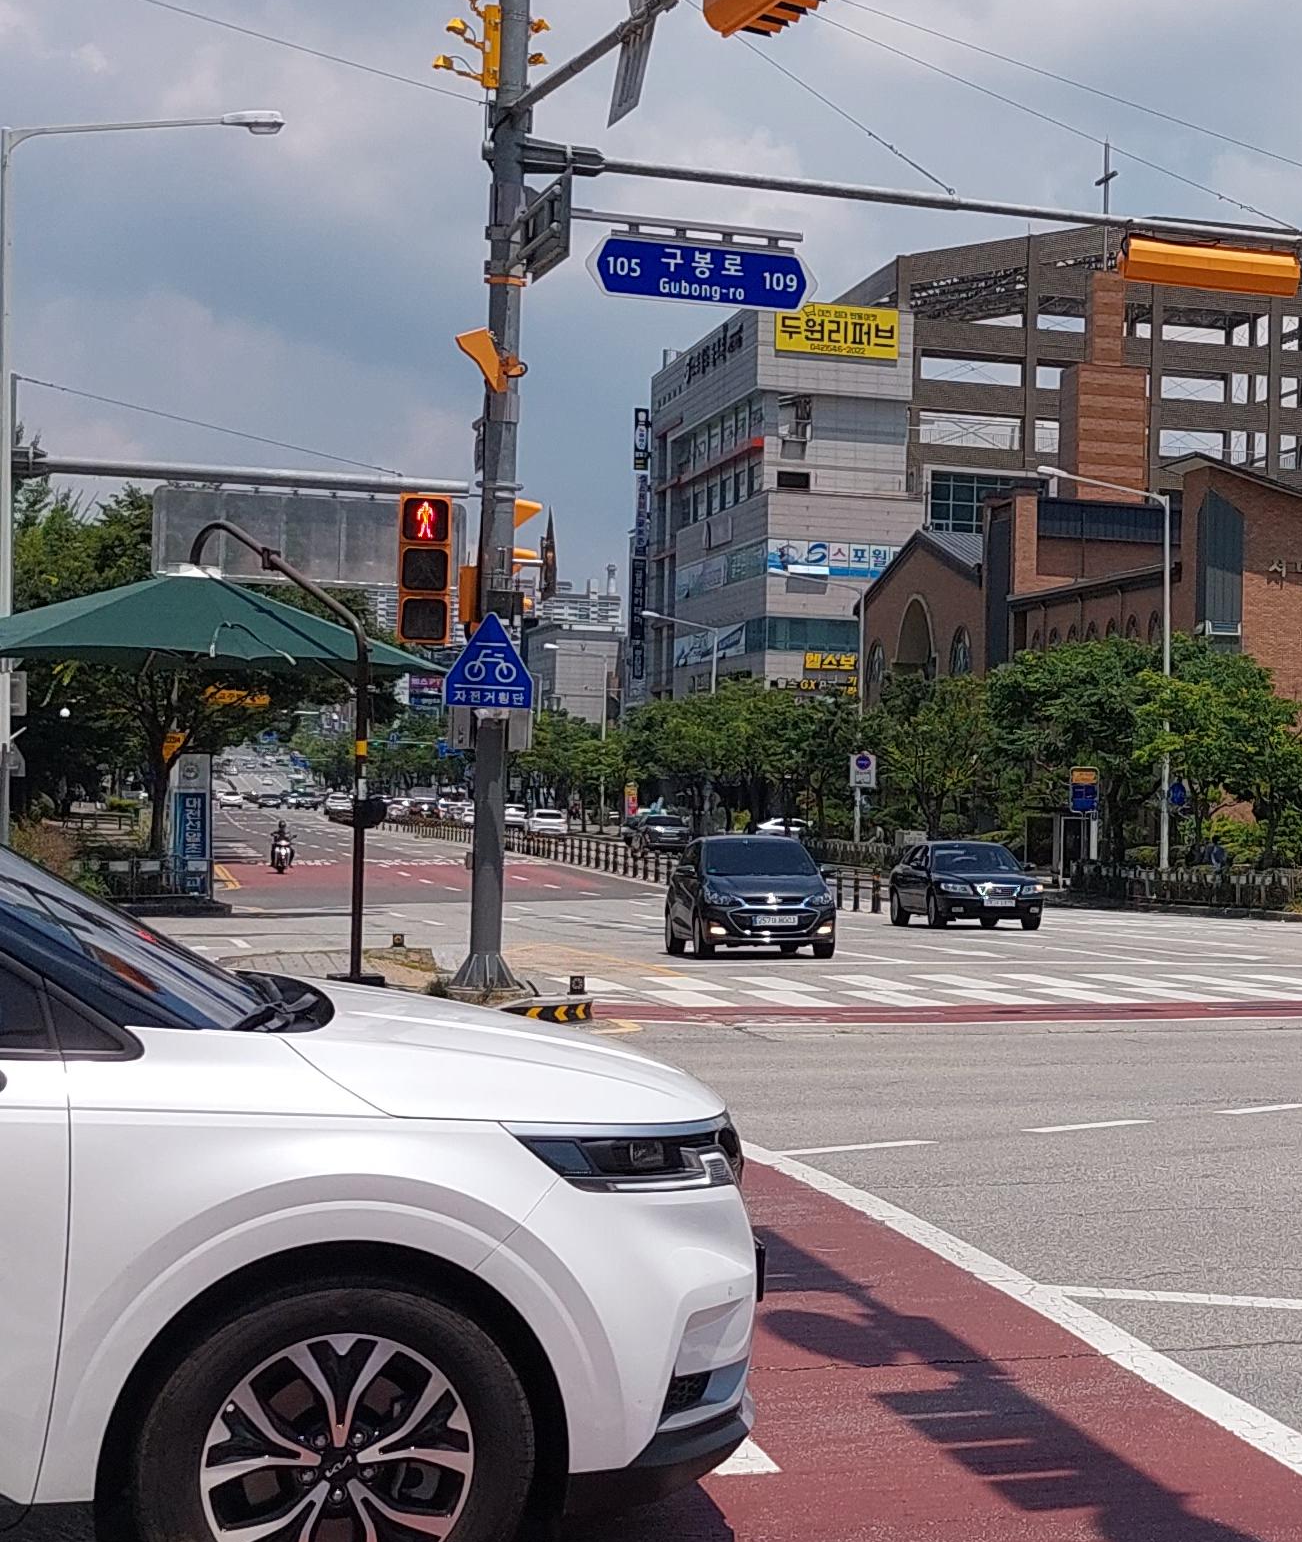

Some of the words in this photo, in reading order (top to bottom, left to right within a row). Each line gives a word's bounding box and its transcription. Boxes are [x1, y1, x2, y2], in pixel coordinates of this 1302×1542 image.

[607, 256, 641, 277] 105
[661, 248, 744, 279] 구봉로
[659, 277, 745, 301] Gubong-ro
[763, 272, 798, 292] 109
[780, 315, 895, 347] 두원리퍼브
[832, 546, 900, 568] 스포월
[800, 679, 817, 690] GX
[452, 689, 525, 705] 자전거횡단
